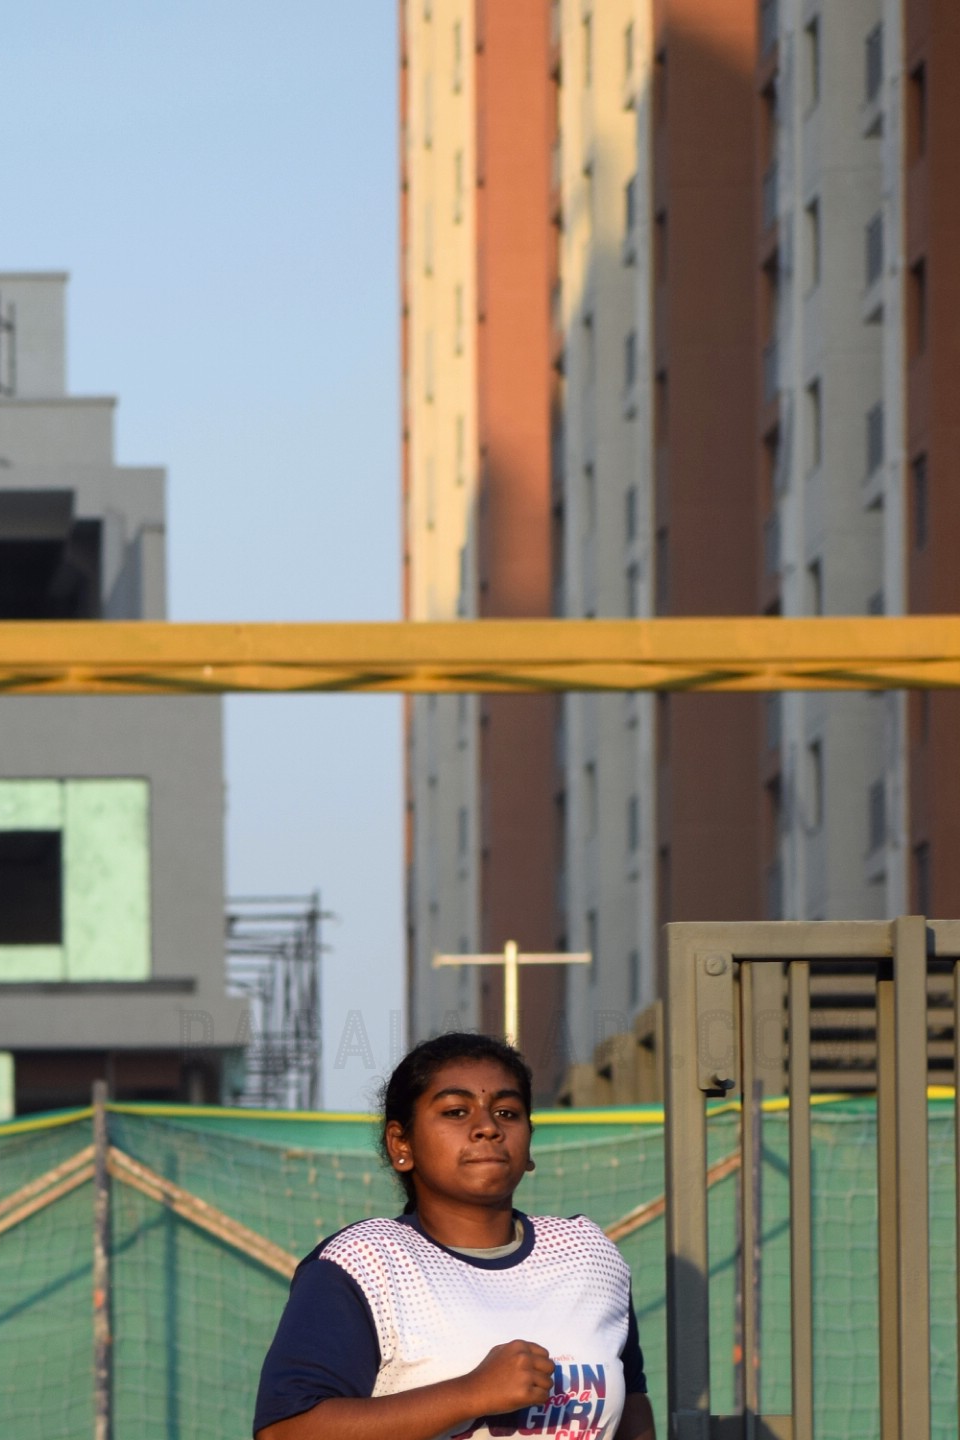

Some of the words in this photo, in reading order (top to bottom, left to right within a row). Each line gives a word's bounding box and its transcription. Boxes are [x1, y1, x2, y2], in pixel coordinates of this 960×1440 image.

[554, 1364, 607, 1399] UN
[517, 1399, 607, 1436] GIRL
[543, 1390, 578, 1414] for
[579, 1389, 592, 1403] a
